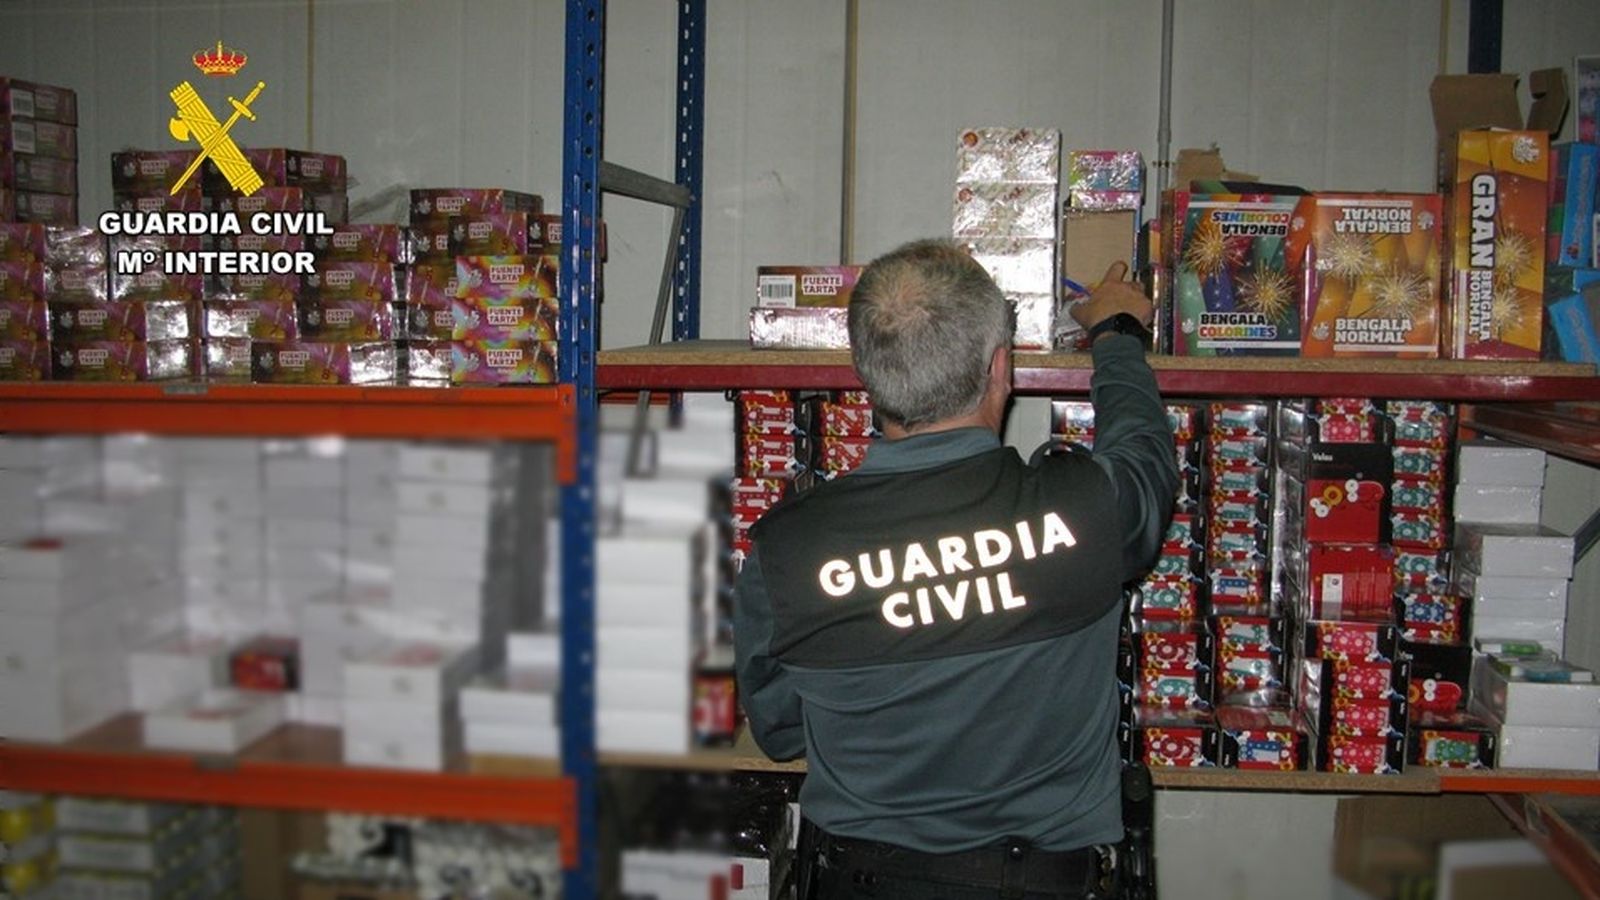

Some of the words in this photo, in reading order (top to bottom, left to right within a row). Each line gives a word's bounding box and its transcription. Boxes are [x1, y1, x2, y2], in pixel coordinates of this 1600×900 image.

[1213, 212, 1290, 224] COLORINES
[1342, 209, 1411, 220] NORMAL
[1335, 221, 1411, 233] BENGALA
[1471, 175, 1496, 269] GRAN
[1222, 224, 1287, 236] BENGALA
[491, 265, 524, 274] FUENTE
[491, 274, 518, 283] TARTA
[803, 276, 842, 285] FUENTE
[804, 285, 836, 294] TARTA
[1469, 270, 1481, 335] NORMAL
[1480, 270, 1492, 341] BENGALA
[489, 307, 522, 316] FUENTE
[489, 316, 517, 325] TARTA
[1200, 314, 1266, 325] BENGALA
[1335, 318, 1412, 331] BENGALA
[1199, 325, 1277, 338] COLORINES
[1334, 331, 1405, 343] NORMAL
[488, 350, 522, 358] FUENTE
[488, 358, 516, 367] TARTA
[818, 512, 1077, 597] GUARDIA
[881, 571, 1027, 628] CIVIL
